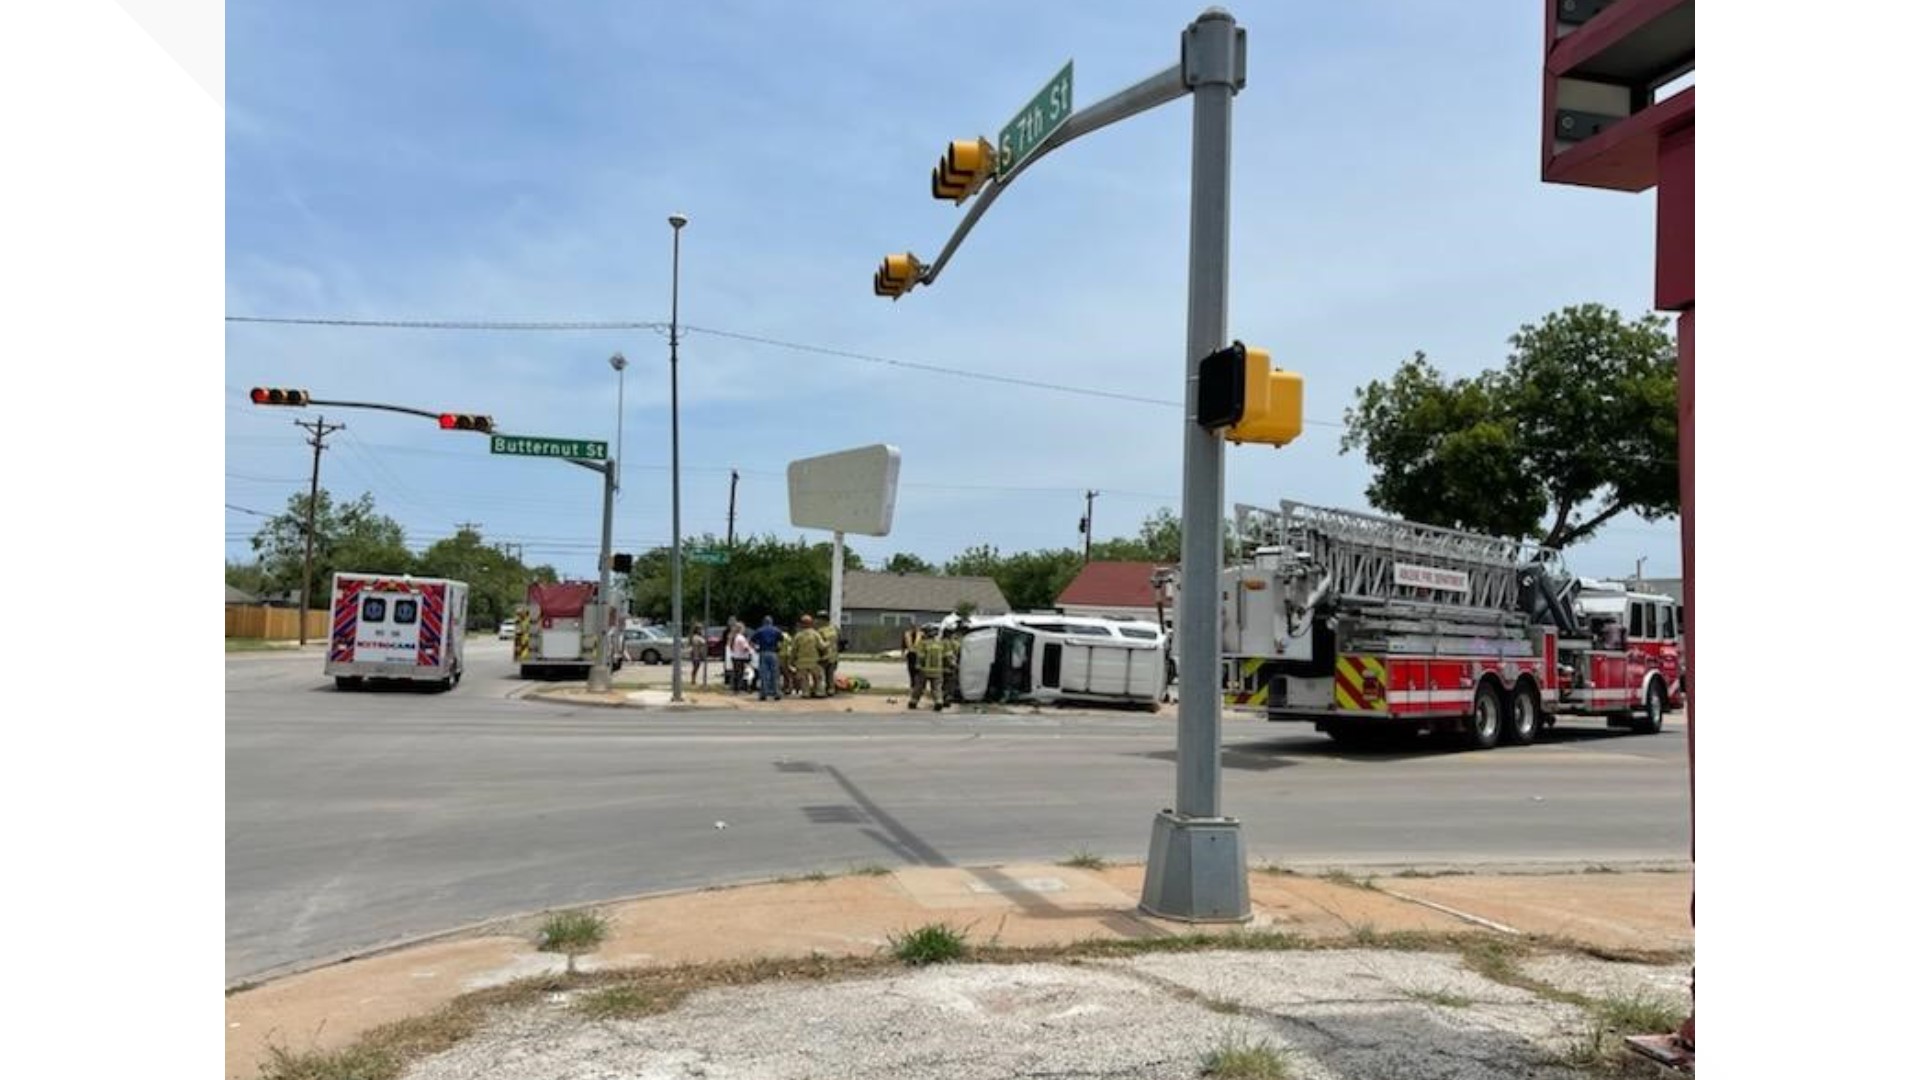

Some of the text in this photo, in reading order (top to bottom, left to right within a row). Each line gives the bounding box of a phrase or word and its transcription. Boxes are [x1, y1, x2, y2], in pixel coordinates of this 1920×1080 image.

[1001, 77, 1068, 166] S 7th St
[494, 437, 605, 458] Butternut St
